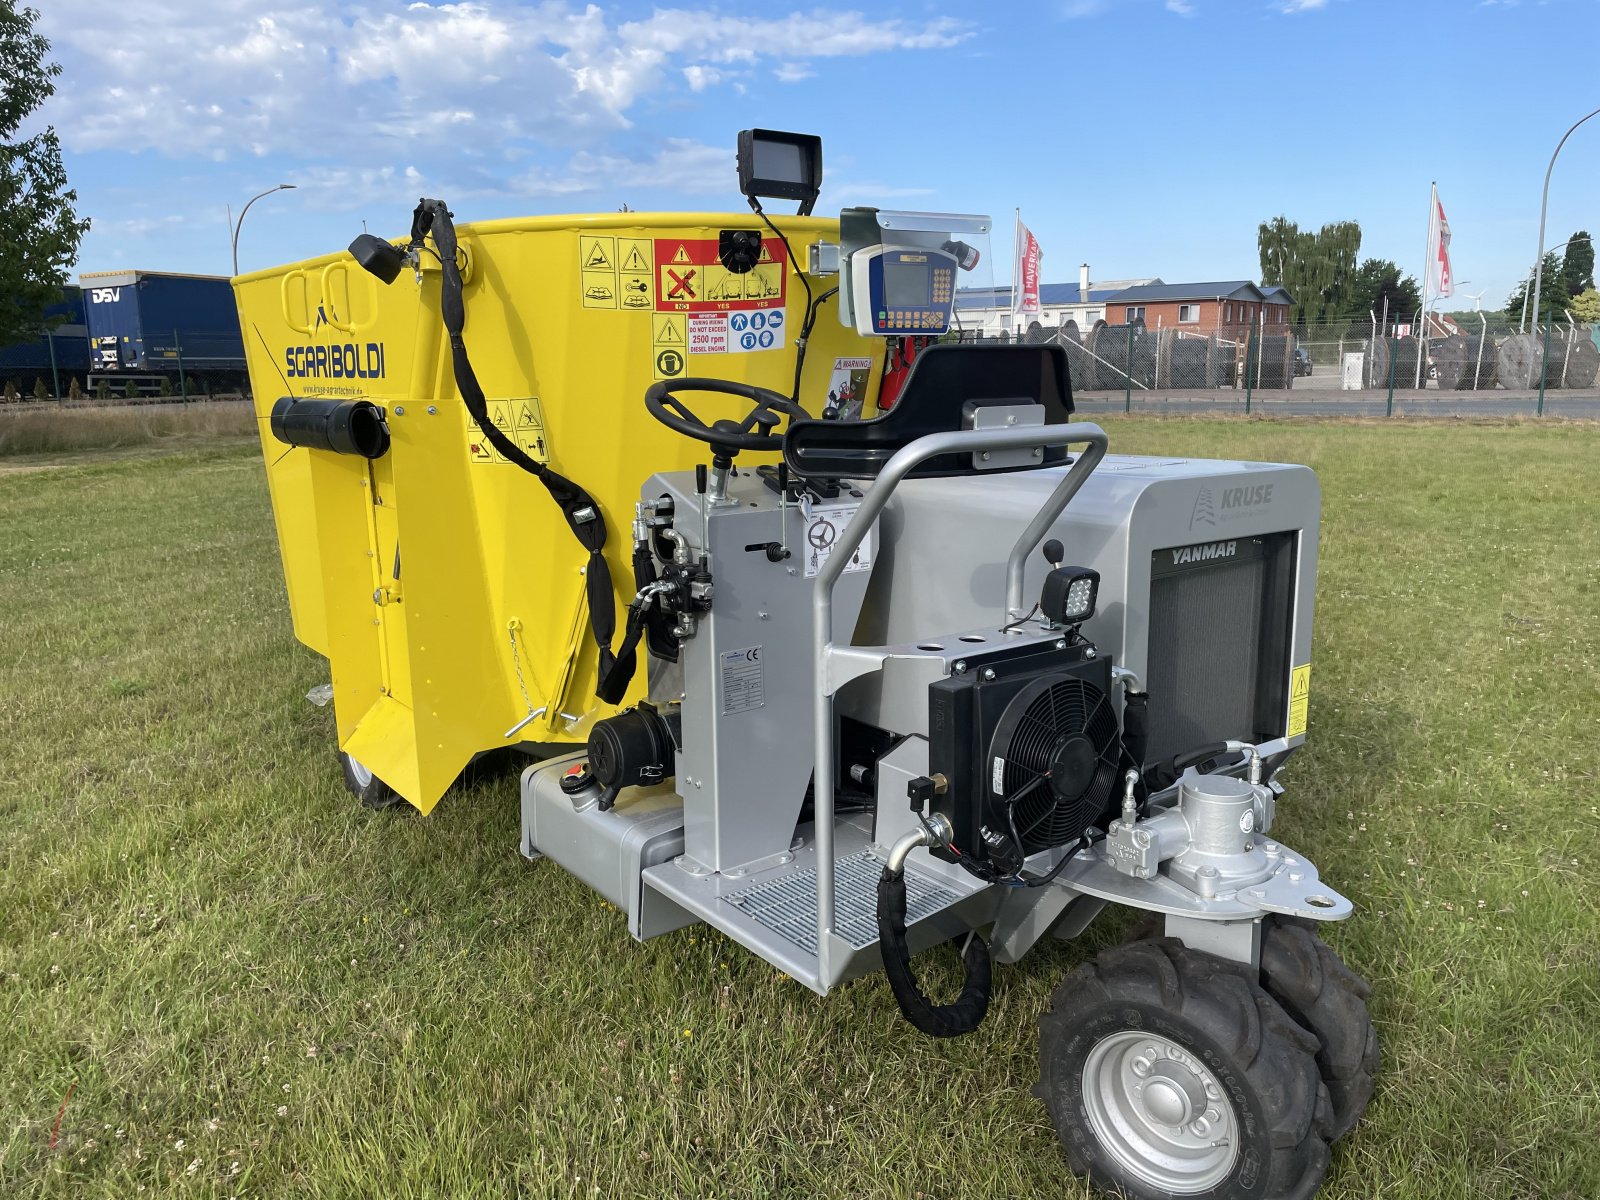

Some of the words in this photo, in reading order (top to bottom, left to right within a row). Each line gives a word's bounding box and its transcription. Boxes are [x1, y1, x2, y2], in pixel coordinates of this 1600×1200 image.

[91, 287, 120, 304] DSV
[693, 335, 709, 344] 2500
[711, 336, 724, 345] rpm
[286, 342, 385, 379] SGARIBOLDI
[1221, 484, 1274, 509] KRUSE
[1172, 541, 1237, 565] YANMAR
[746, 648, 759, 662] CE
